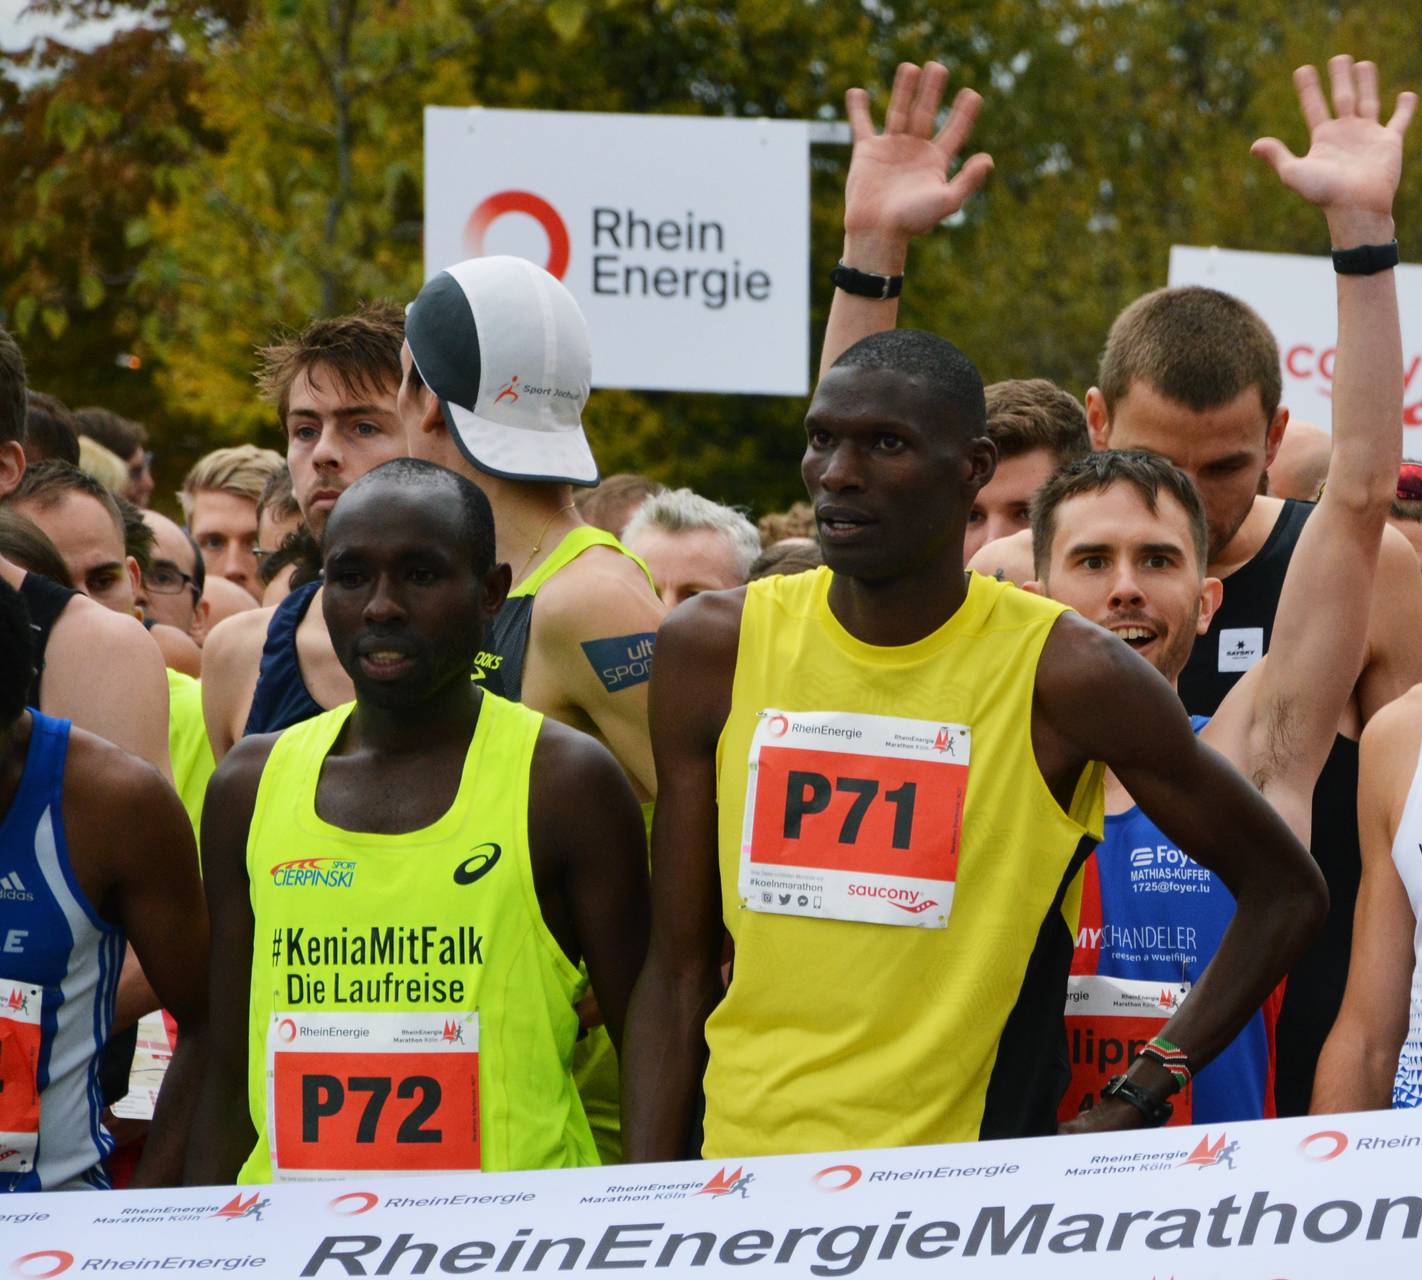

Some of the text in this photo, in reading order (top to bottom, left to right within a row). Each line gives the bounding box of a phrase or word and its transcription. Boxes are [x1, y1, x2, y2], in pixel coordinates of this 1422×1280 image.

[592, 207, 724, 253] Rhein
[592, 254, 772, 309] Energie
[791, 722, 863, 740] RheinEnergie
[783, 770, 917, 850] P71
[1156, 845, 1198, 868] Foy
[332, 860, 357, 871] SPORT
[273, 869, 353, 888] CIERPINSKI
[1130, 868, 1211, 882] MATHIAS-KUFFER
[750, 876, 824, 892] #koelnmarathon
[1132, 881, 1211, 894] 1725@foyer.lu
[847, 883, 920, 905] saucony
[272, 926, 484, 967] #KeniaMitFalk
[1112, 951, 1142, 962] reesen
[286, 972, 465, 1005] Die Laufreise
[299, 1025, 370, 1040] RheinEnergie
[301, 1074, 443, 1144] P72
[1090, 1149, 1189, 1165] RheinEnergie
[868, 1162, 1020, 1183] RheinEnergie
[1064, 1161, 1173, 1177] Marathon Köln
[606, 1180, 704, 1194] RheinEnergie
[384, 1191, 536, 1210] RheinEnergie
[579, 1189, 688, 1206] Marathon Köln
[120, 1205, 219, 1216] RheinEnergie
[93, 1214, 201, 1225] Marathon Köln
[80, 1254, 267, 1271] RheinEnergie
